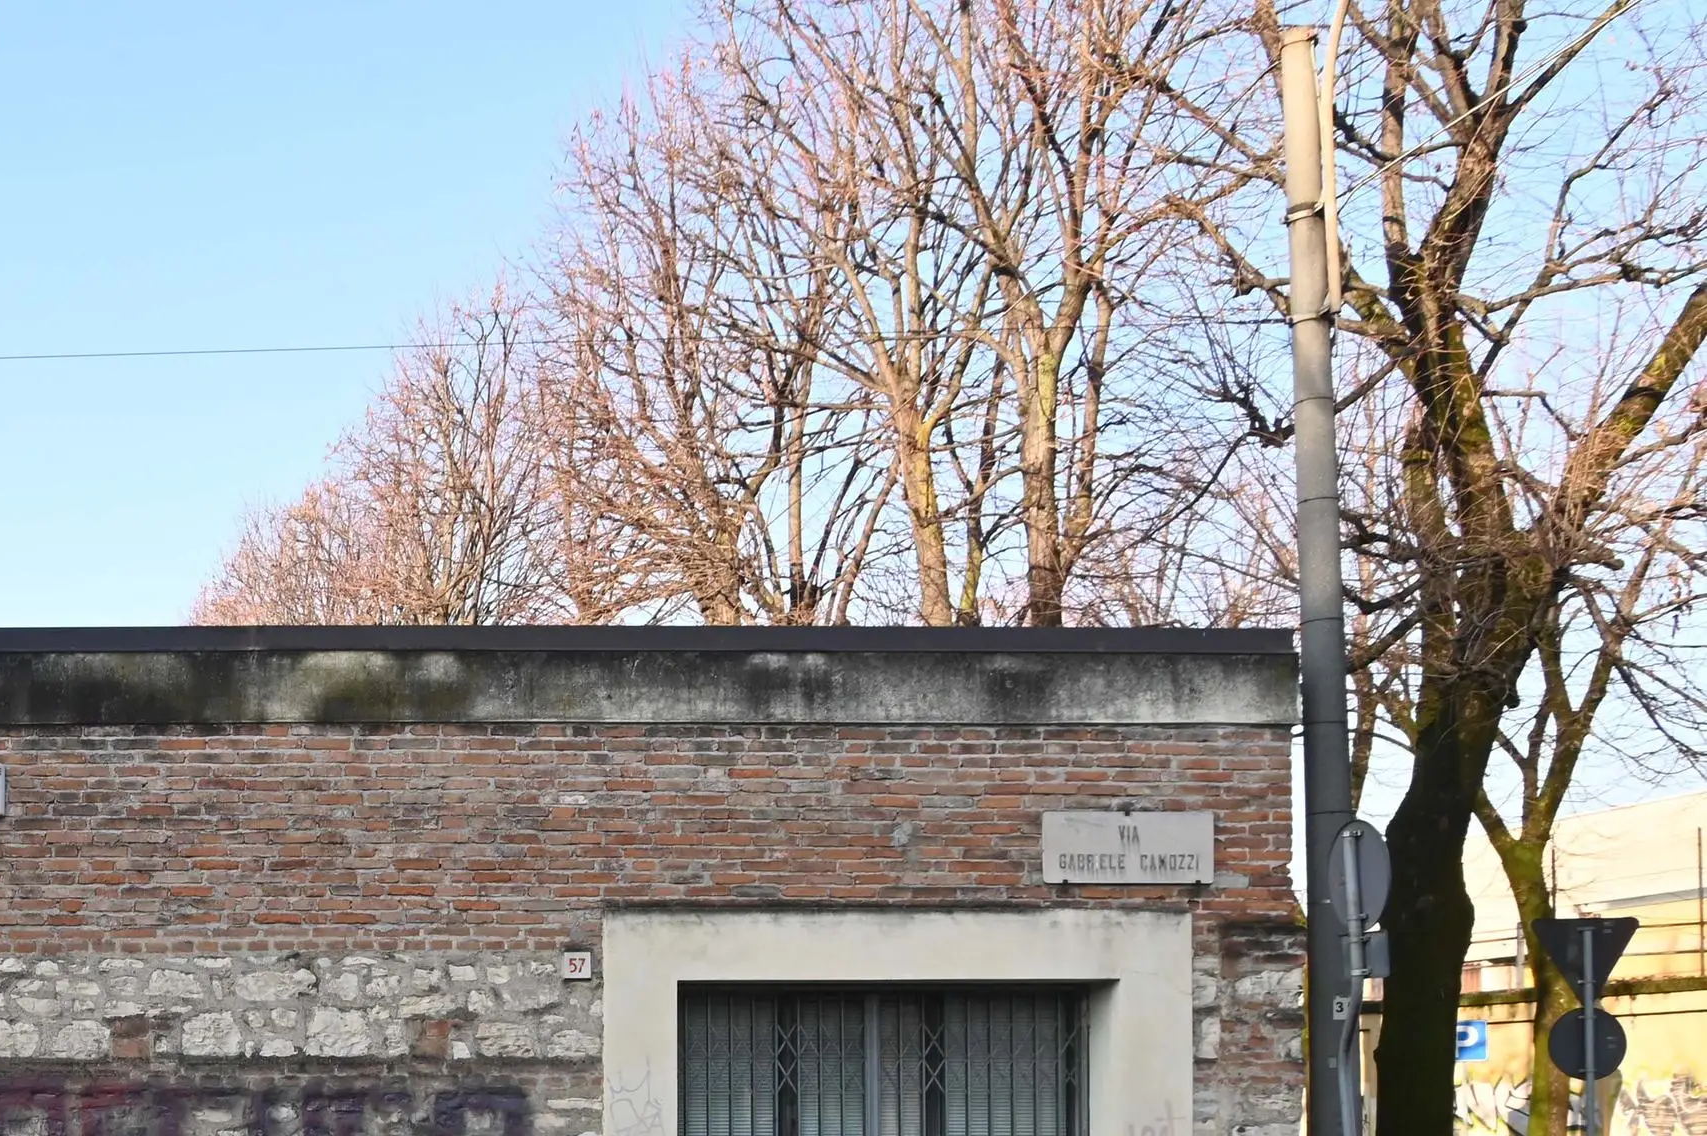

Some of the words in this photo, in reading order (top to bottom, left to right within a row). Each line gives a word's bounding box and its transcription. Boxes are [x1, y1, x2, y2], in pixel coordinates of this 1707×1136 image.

[1118, 825, 1140, 843] VIA
[1139, 853, 1200, 872] CAMOZZI
[568, 957, 586, 974] 57
[1455, 1025, 1480, 1058] P
